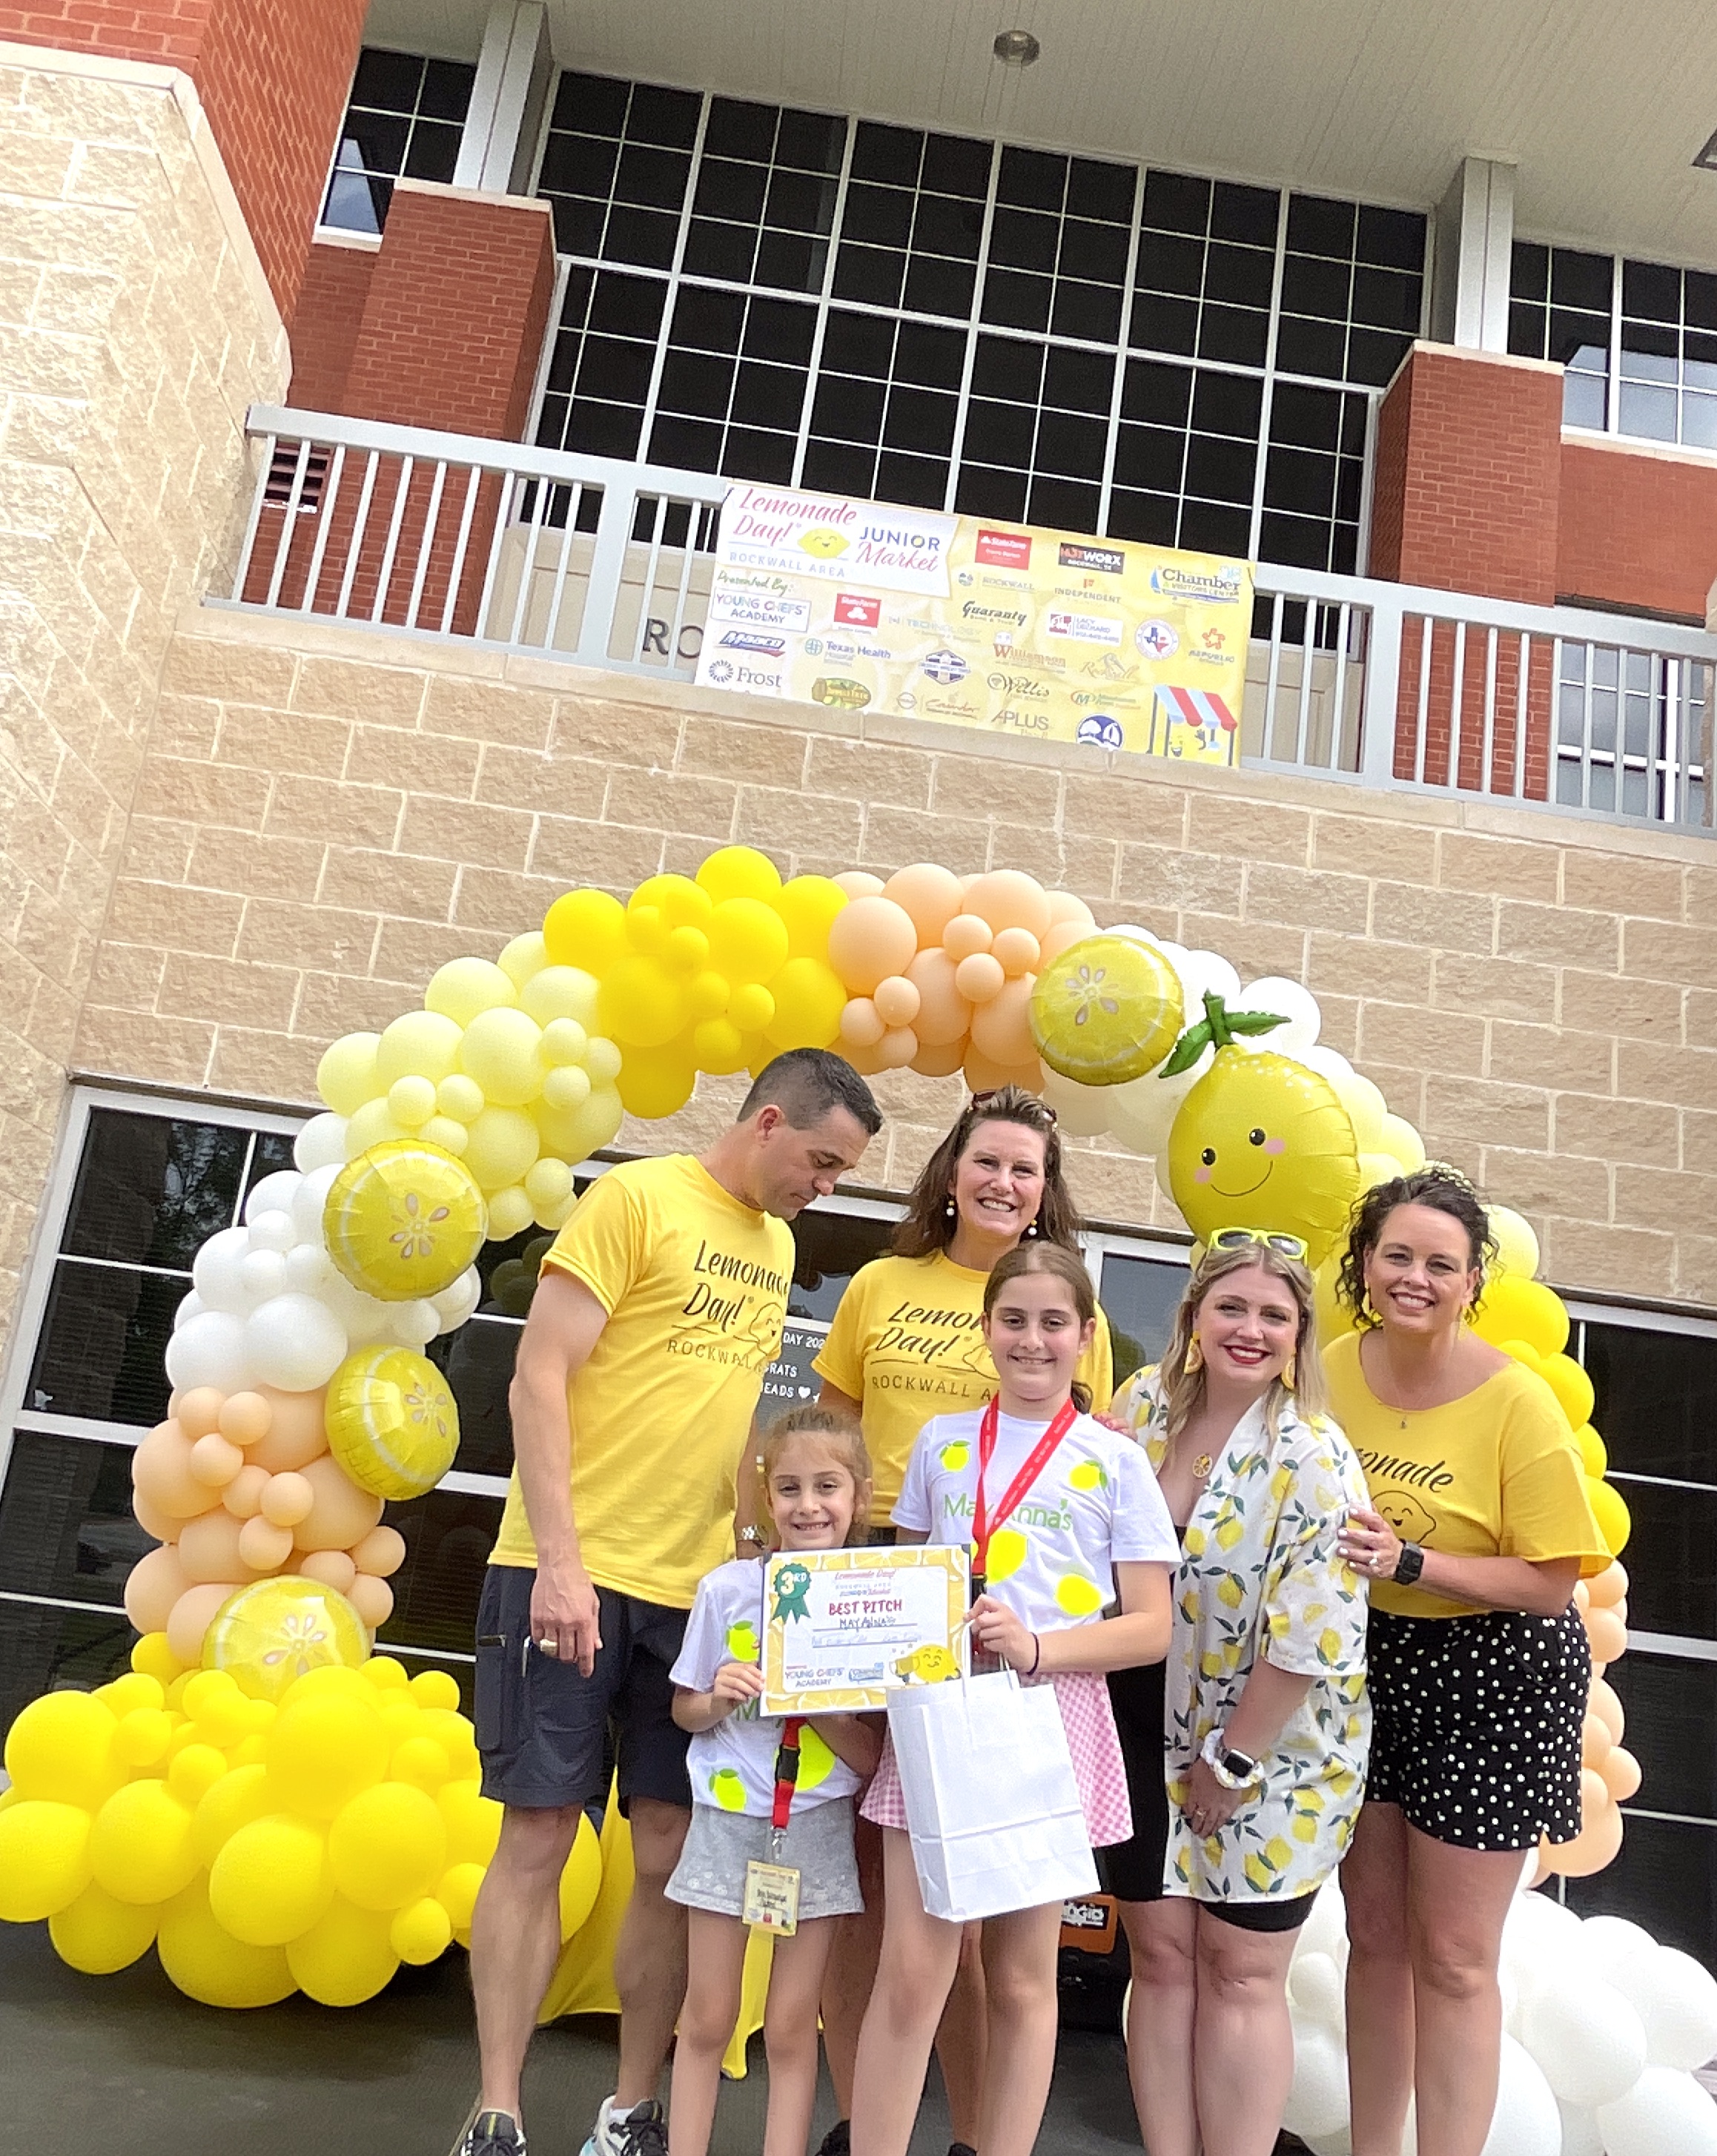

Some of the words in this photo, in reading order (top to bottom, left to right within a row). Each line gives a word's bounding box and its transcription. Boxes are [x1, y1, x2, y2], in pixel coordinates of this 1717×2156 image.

[739, 488, 857, 525] Lemonade
[733, 515, 793, 546] Day!
[859, 526, 940, 551] JUNIOR
[730, 552, 802, 570] ROCKWALL
[809, 563, 845, 578] AREA
[856, 541, 939, 572] Market
[717, 570, 770, 588] Presented
[1162, 568, 1241, 591] Chamber
[717, 594, 760, 609] YOUNG
[764, 601, 802, 616] CHEFS
[1054, 586, 1122, 604] INDEPENDENT
[730, 609, 786, 624] ACADEMY
[962, 601, 1028, 626] Guaranty
[642, 618, 704, 658] RO
[827, 639, 855, 652] Texas
[857, 644, 891, 659] Health
[737, 666, 783, 689] Frost
[784, 1332, 803, 1346] DAY
[805, 1336, 825, 1349] 202
[763, 1382, 795, 1398] EADS
[873, 1375, 970, 1398] ROCKWALL
[1357, 1448, 1455, 1493] onade
[943, 1492, 1073, 1532] Manna's
[829, 1601, 860, 1616] BEST
[862, 1598, 902, 1614] PITCH
[784, 1670, 814, 1679] YOUNG
[795, 1678, 832, 1687] ACADEMY
